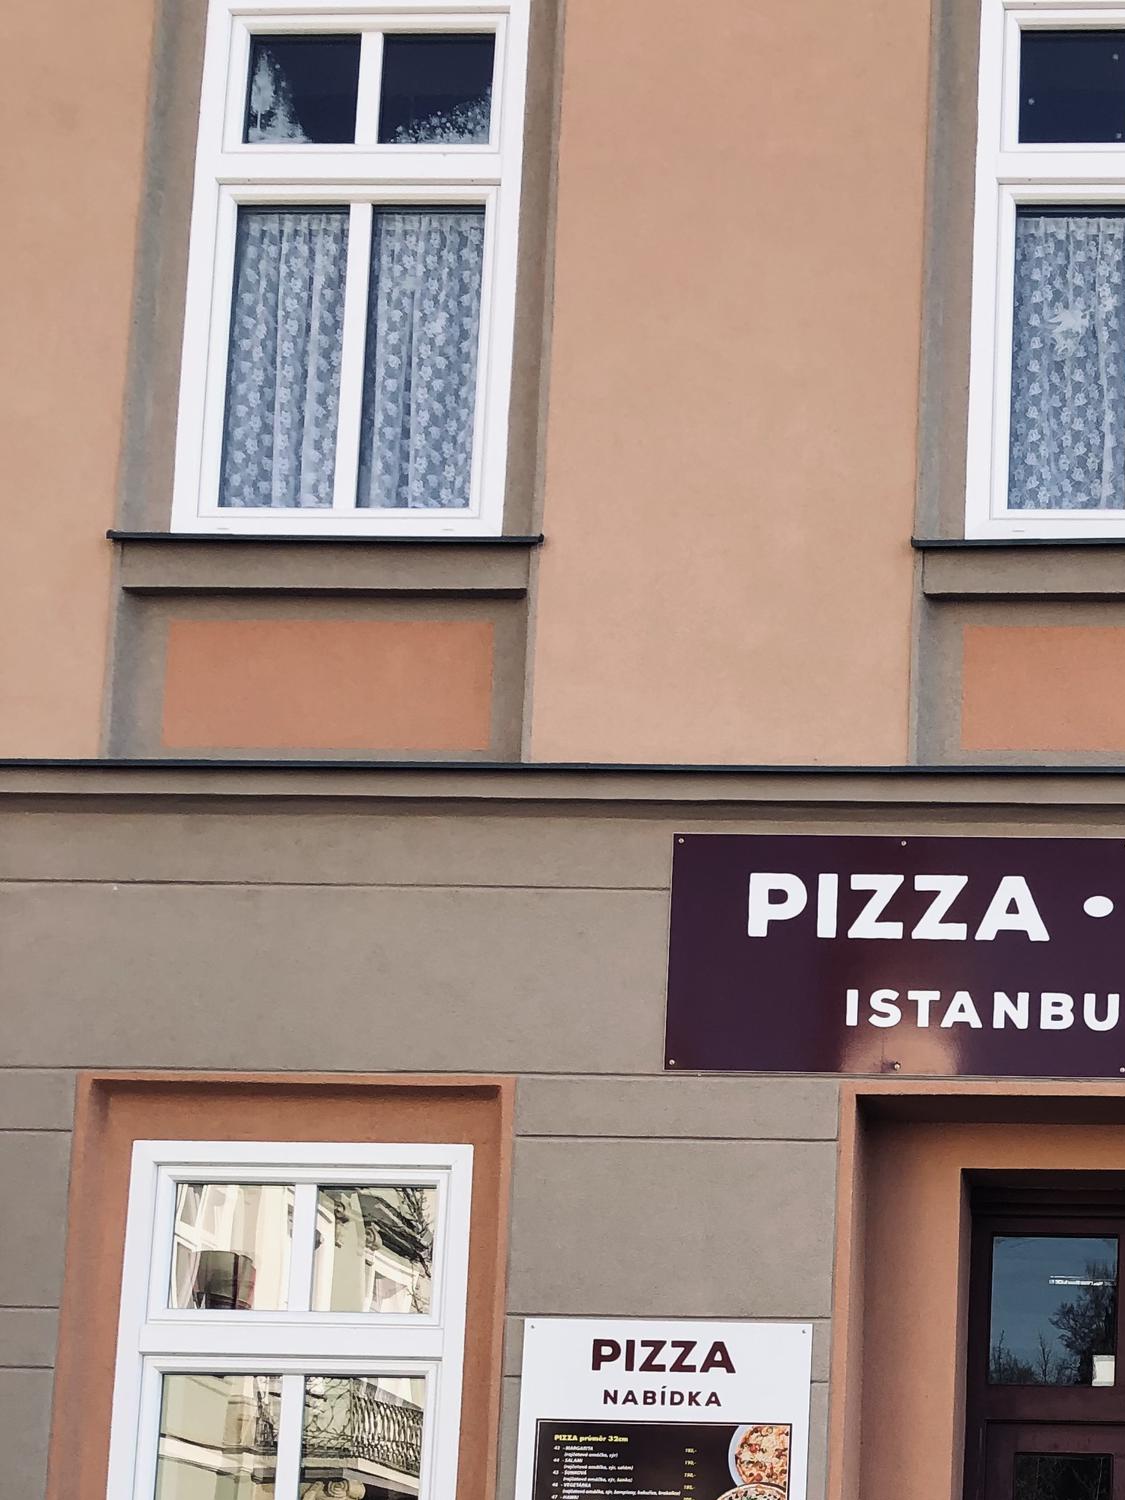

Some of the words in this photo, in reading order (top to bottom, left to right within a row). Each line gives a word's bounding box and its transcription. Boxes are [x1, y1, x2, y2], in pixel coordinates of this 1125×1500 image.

[747, 874, 1049, 940] PIZZA
[592, 1339, 736, 1373] PIZZA
[603, 1385, 722, 1407] NABÍDKA
